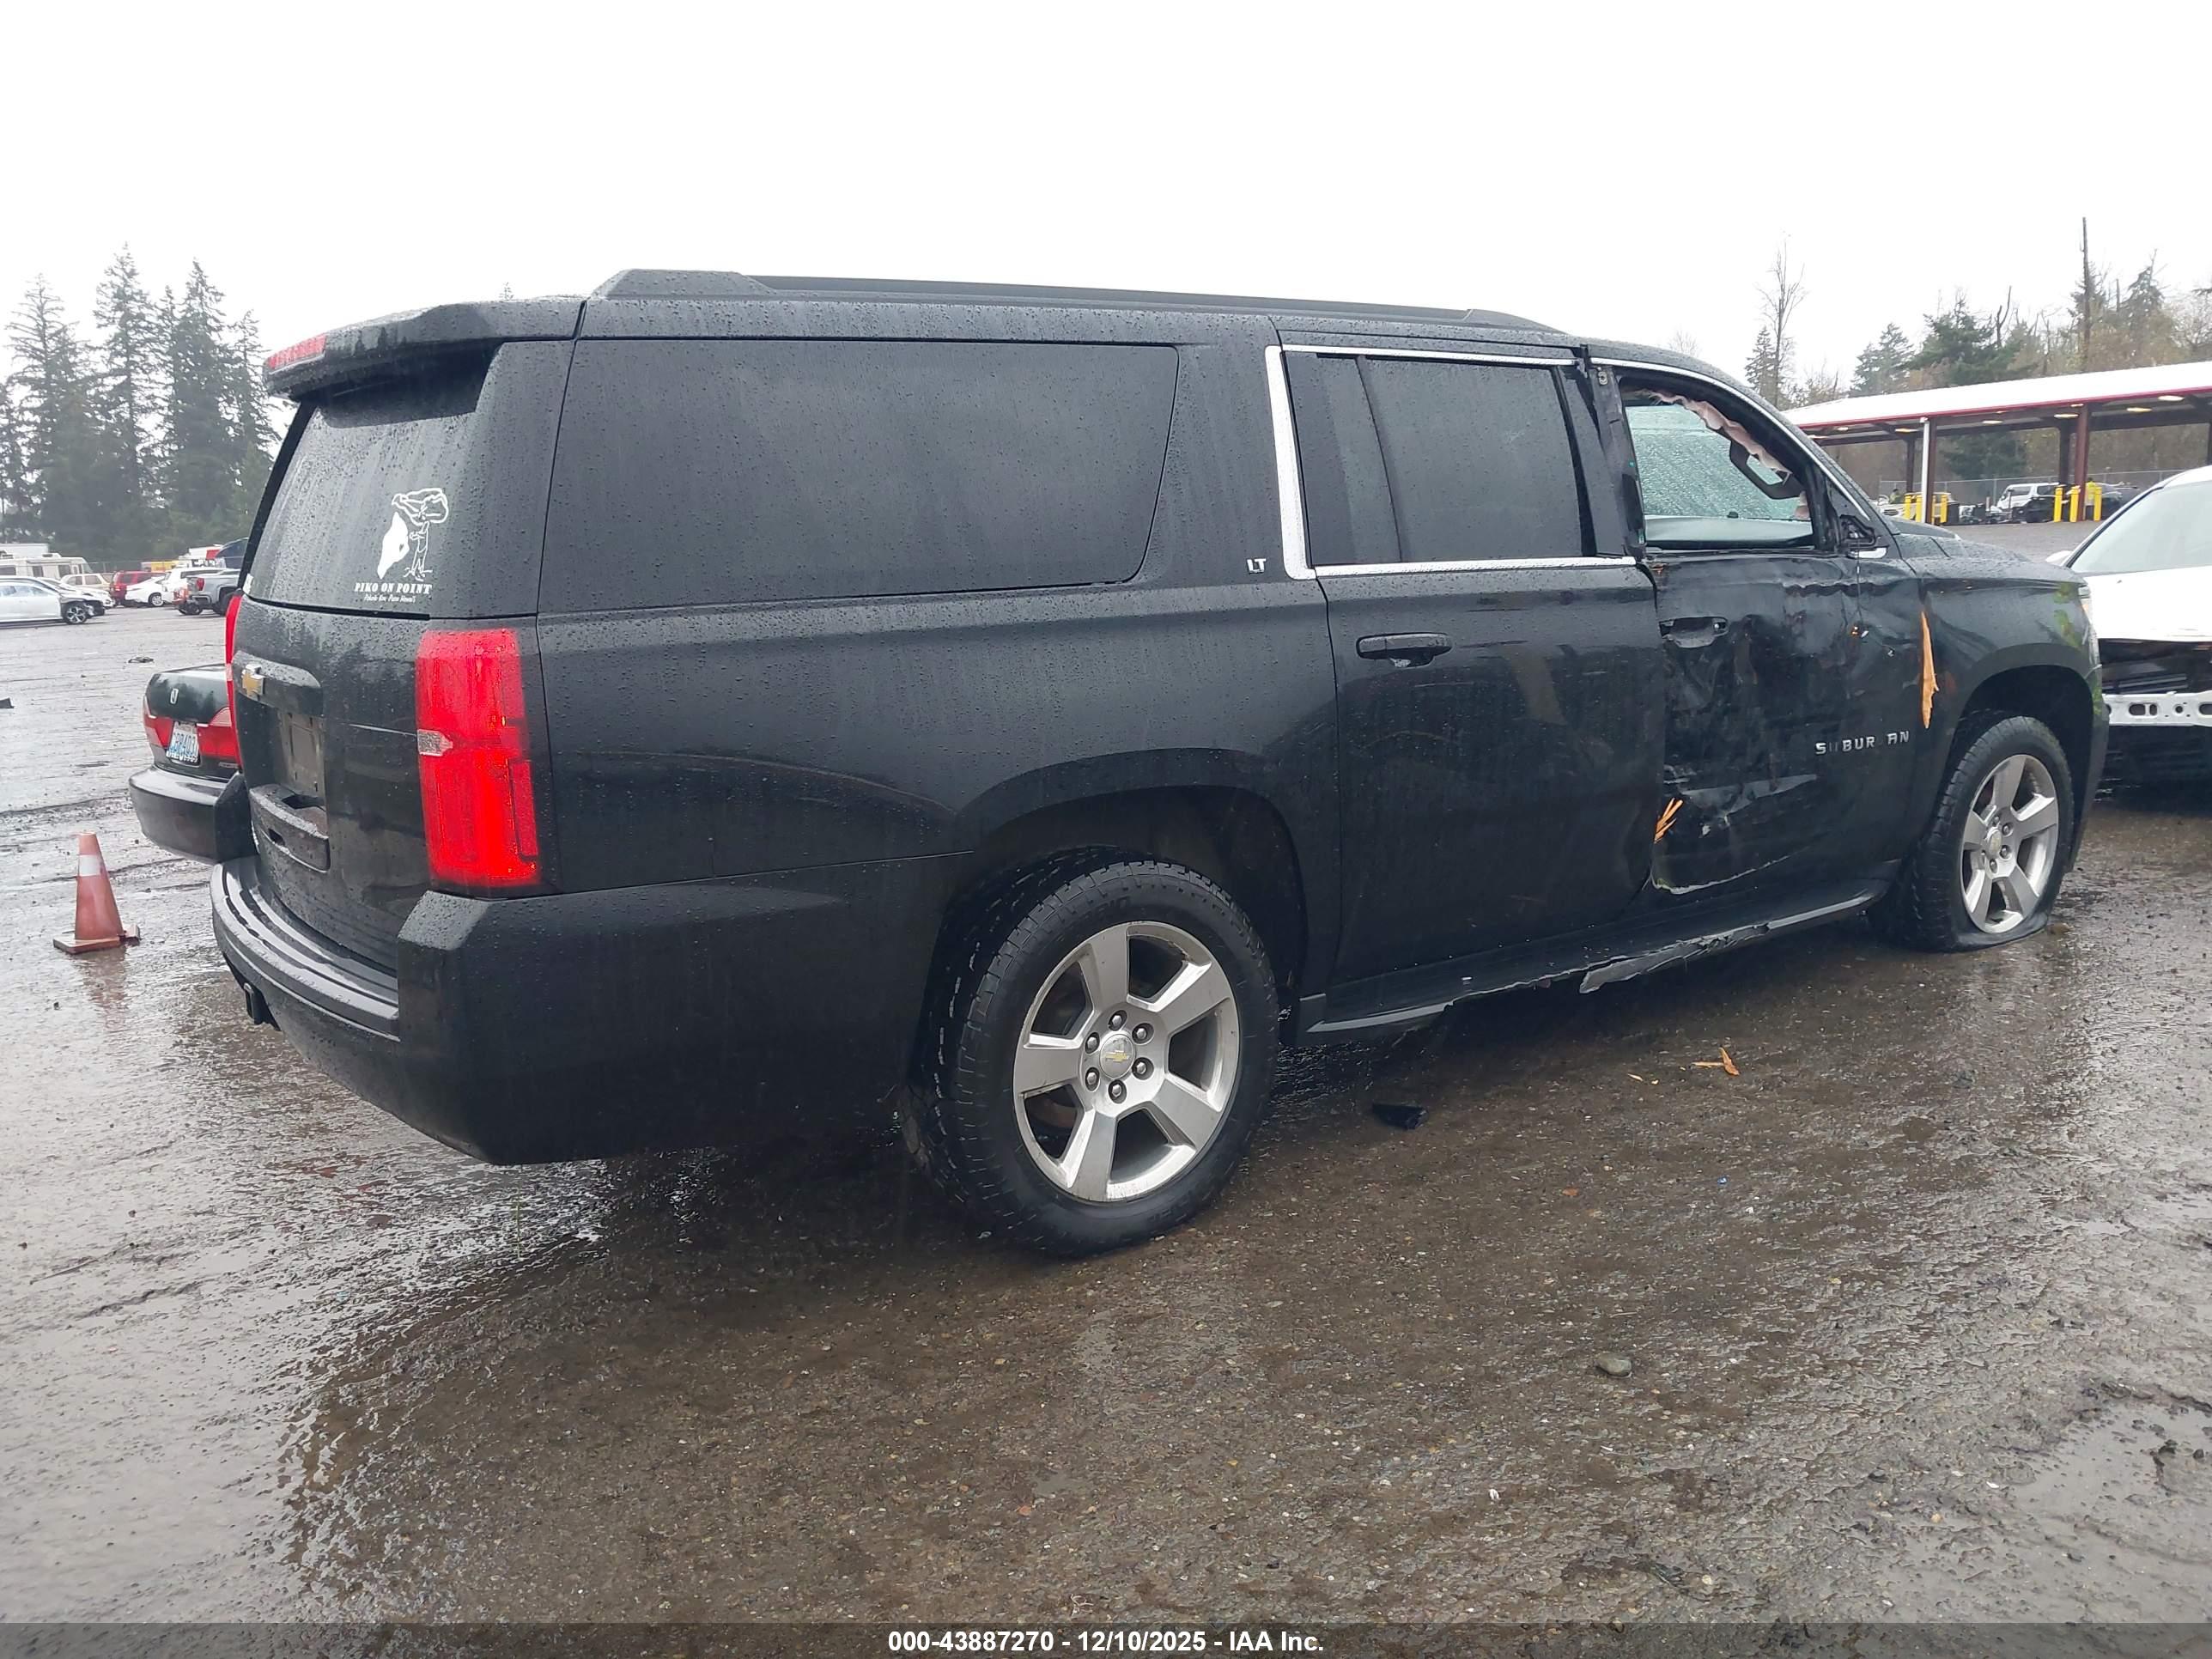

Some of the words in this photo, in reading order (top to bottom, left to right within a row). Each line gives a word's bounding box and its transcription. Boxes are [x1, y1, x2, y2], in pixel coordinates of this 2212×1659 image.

[1247, 558, 1267, 574] LT
[354, 582, 379, 592] PIKO
[380, 582, 395, 592] ON
[396, 583, 433, 594] POINT
[1815, 731, 1910, 755] SBURAN
